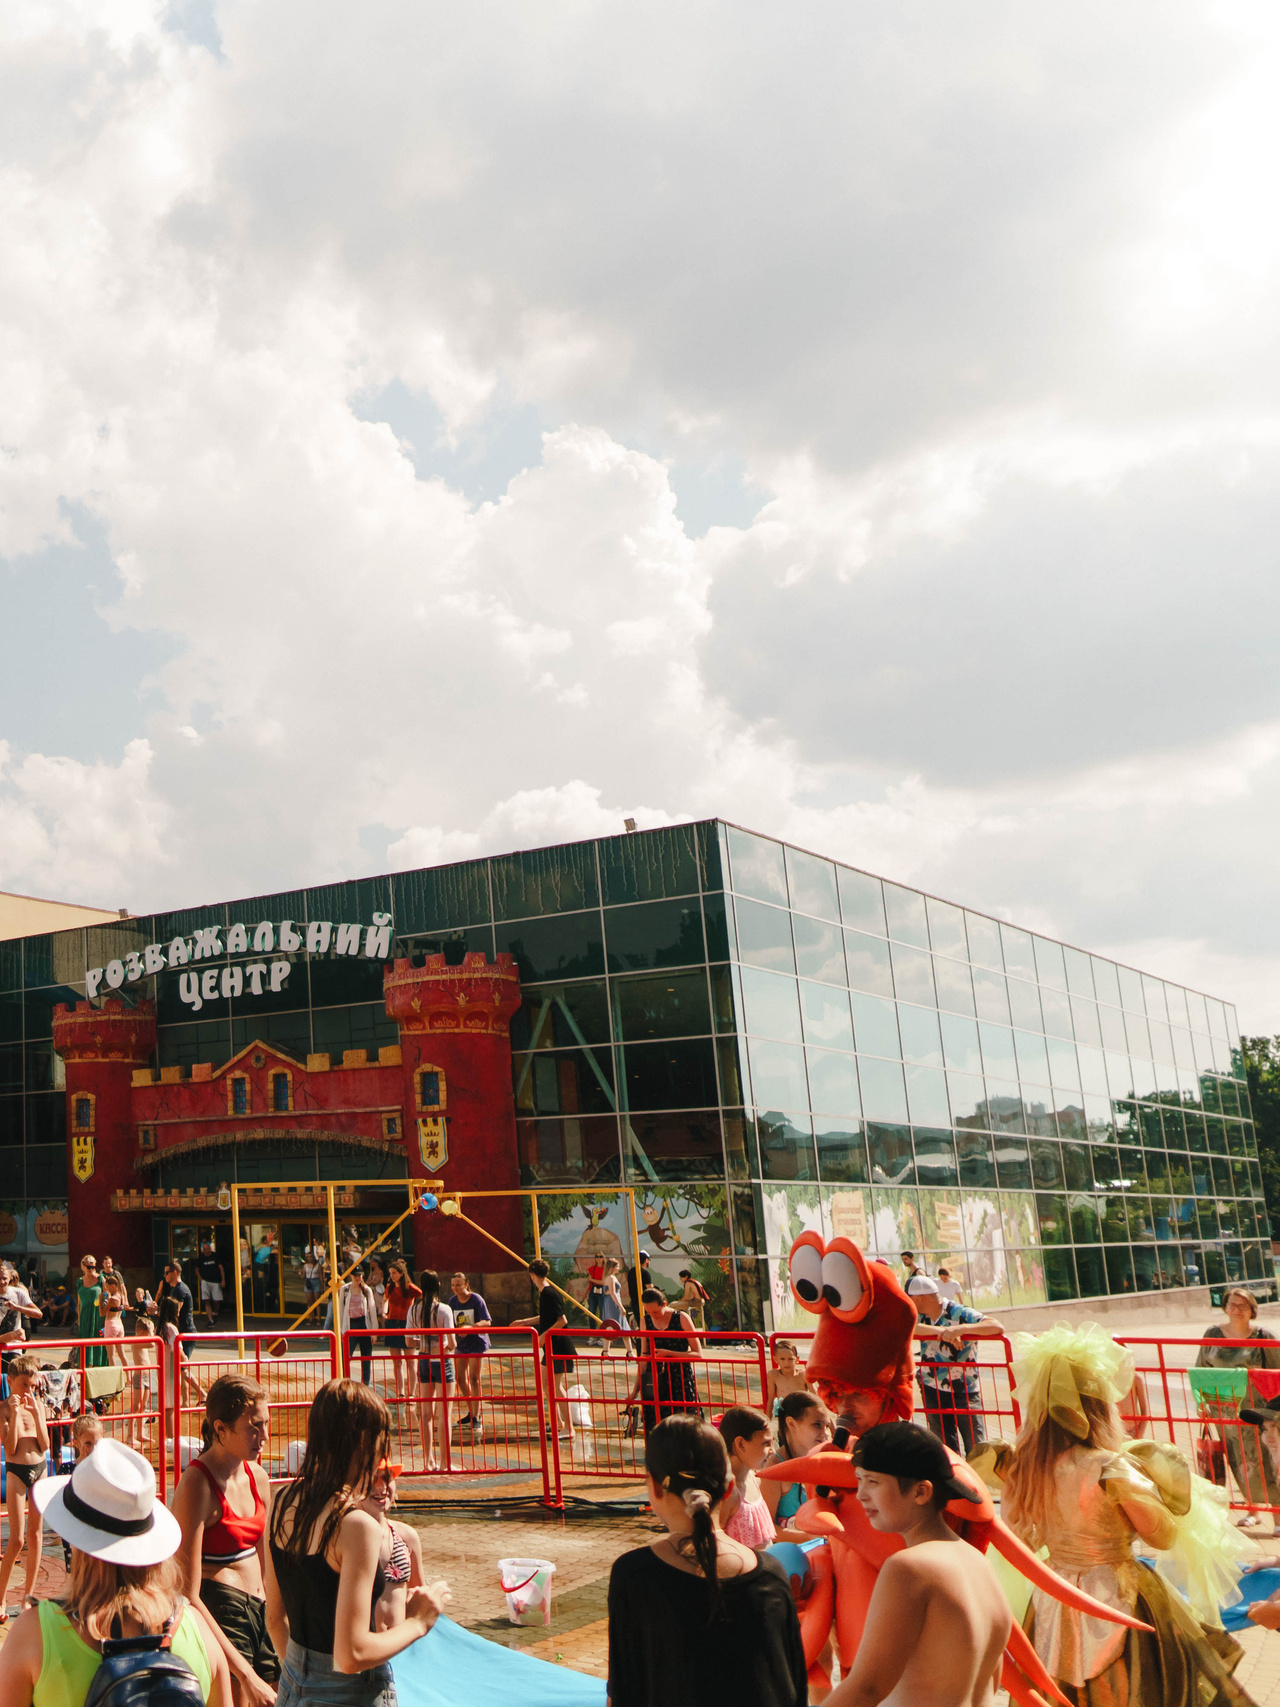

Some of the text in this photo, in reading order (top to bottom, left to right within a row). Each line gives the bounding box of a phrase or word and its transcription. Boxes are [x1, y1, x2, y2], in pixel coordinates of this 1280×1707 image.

[86, 911, 393, 998] РОЗВАЖАЛЬНИЙ
[179, 960, 291, 1011] ЦЕНТР
[39, 1223, 67, 1234] КАССА
